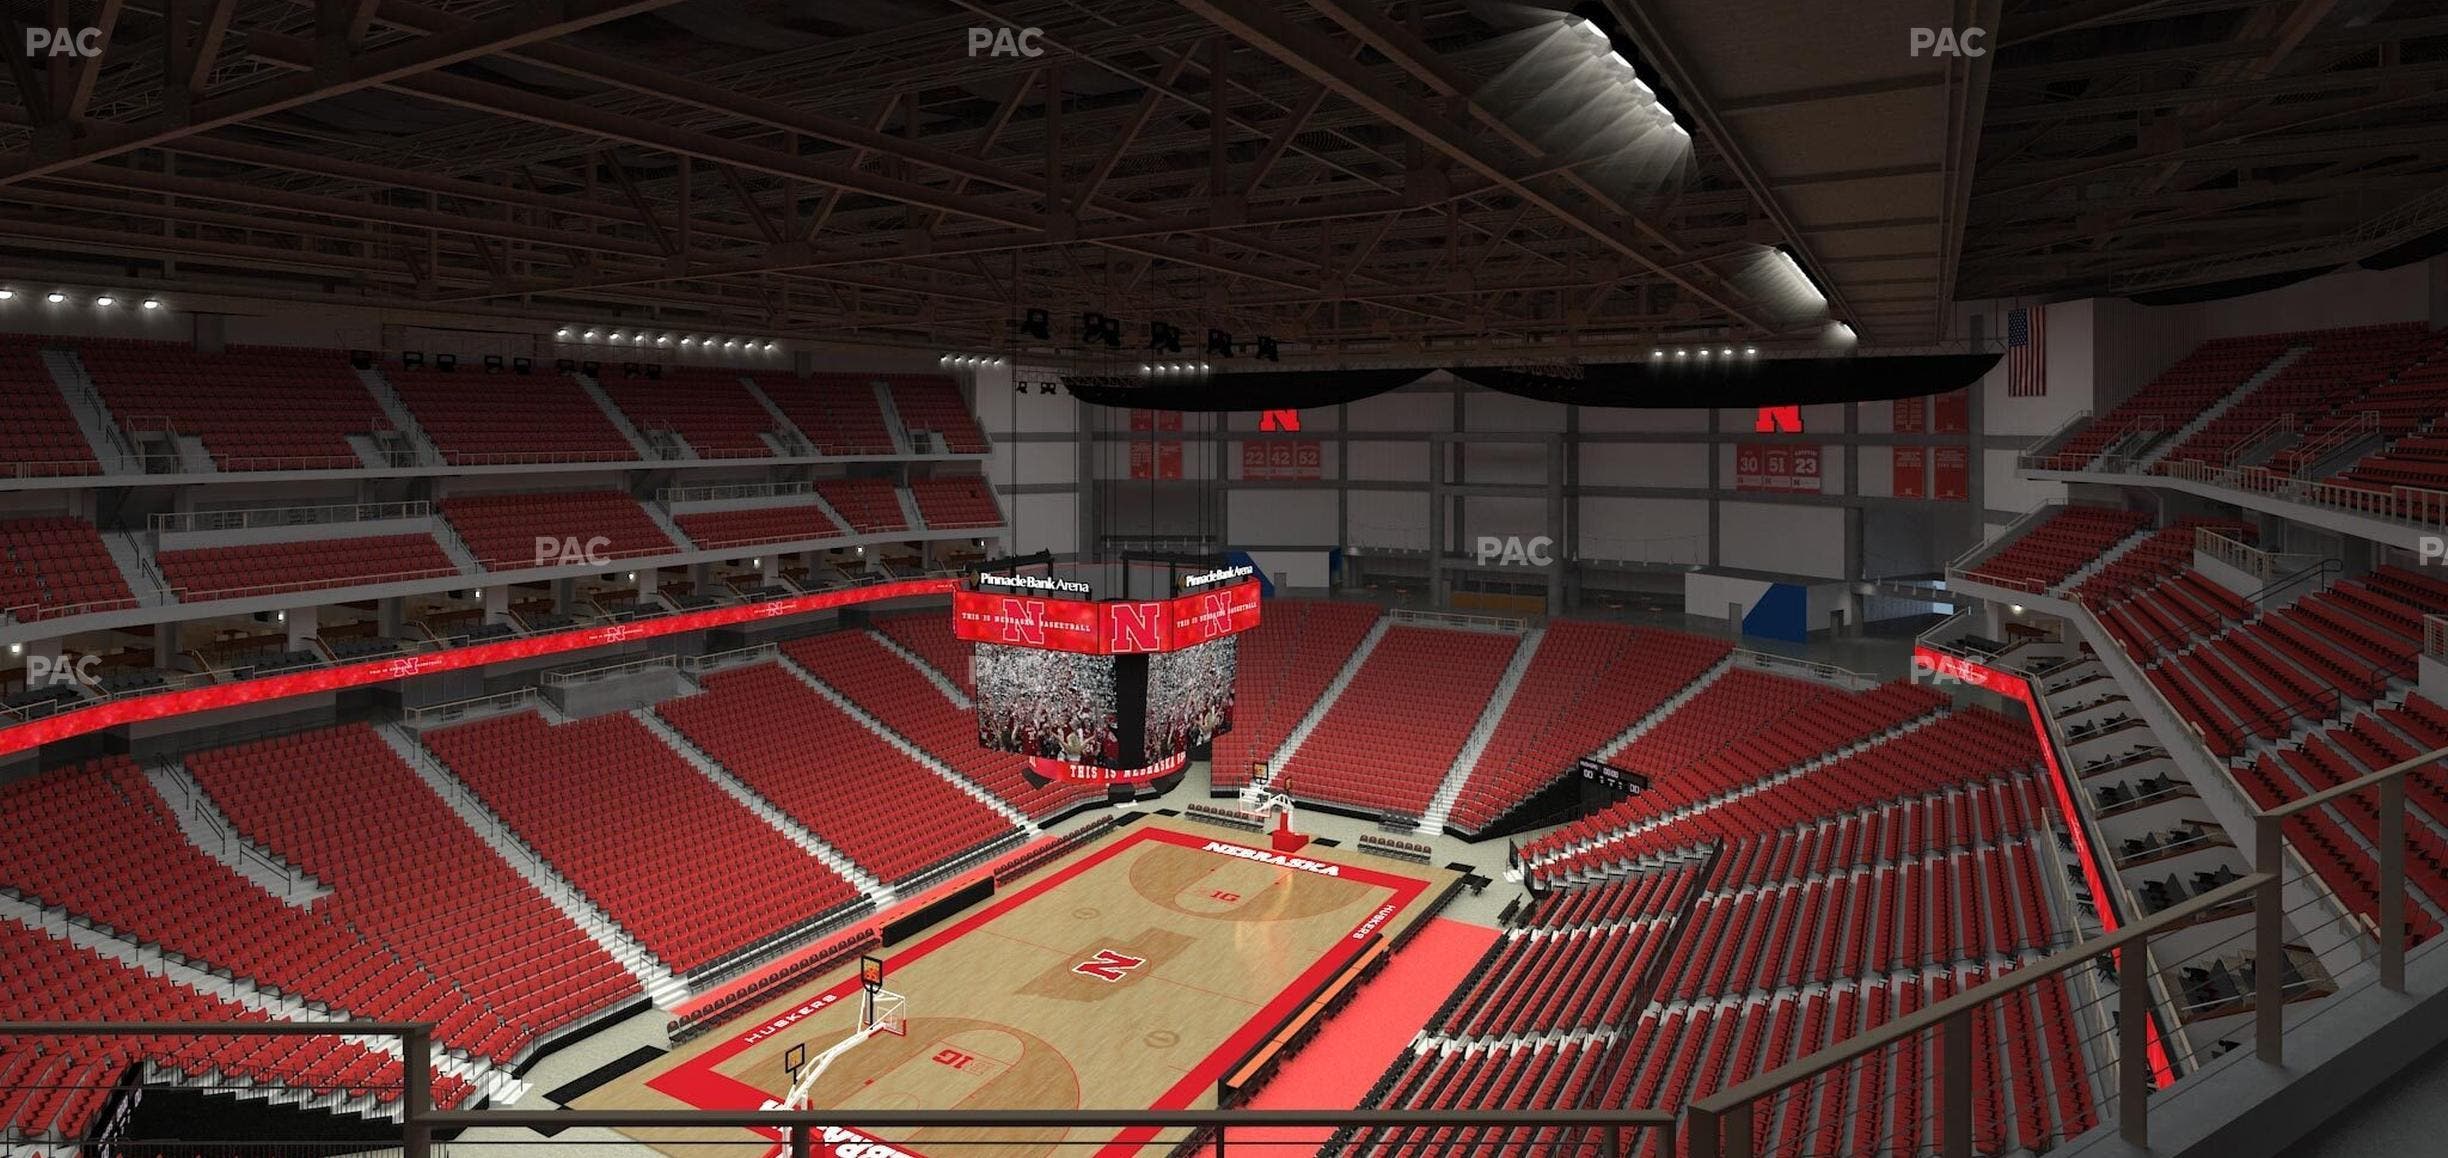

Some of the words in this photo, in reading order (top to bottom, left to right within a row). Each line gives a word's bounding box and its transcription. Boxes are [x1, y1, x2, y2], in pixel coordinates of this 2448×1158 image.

[1245, 451, 1265, 465] 22
[1271, 451, 1290, 465] 42
[1740, 457, 1758, 473] 30
[1769, 457, 1785, 473] 51
[1795, 458, 1817, 474] 23
[1235, 565, 1253, 577] Arena
[980, 572, 1027, 588] Pinnacle
[1026, 576, 1056, 590] Bank
[1056, 578, 1090, 593] Arena
[961, 612, 980, 621] THIS
[983, 614, 991, 622] IS
[1003, 599, 1044, 645] N
[1205, 591, 1232, 638] N
[1111, 603, 1160, 653] N
[1069, 764, 1098, 779] THIS
[1202, 841, 1341, 877] NEBRASKA
[1352, 904, 1397, 940] HUSKERS
[1071, 948, 1146, 983] N
[745, 993, 838, 1044] HUSKERS
